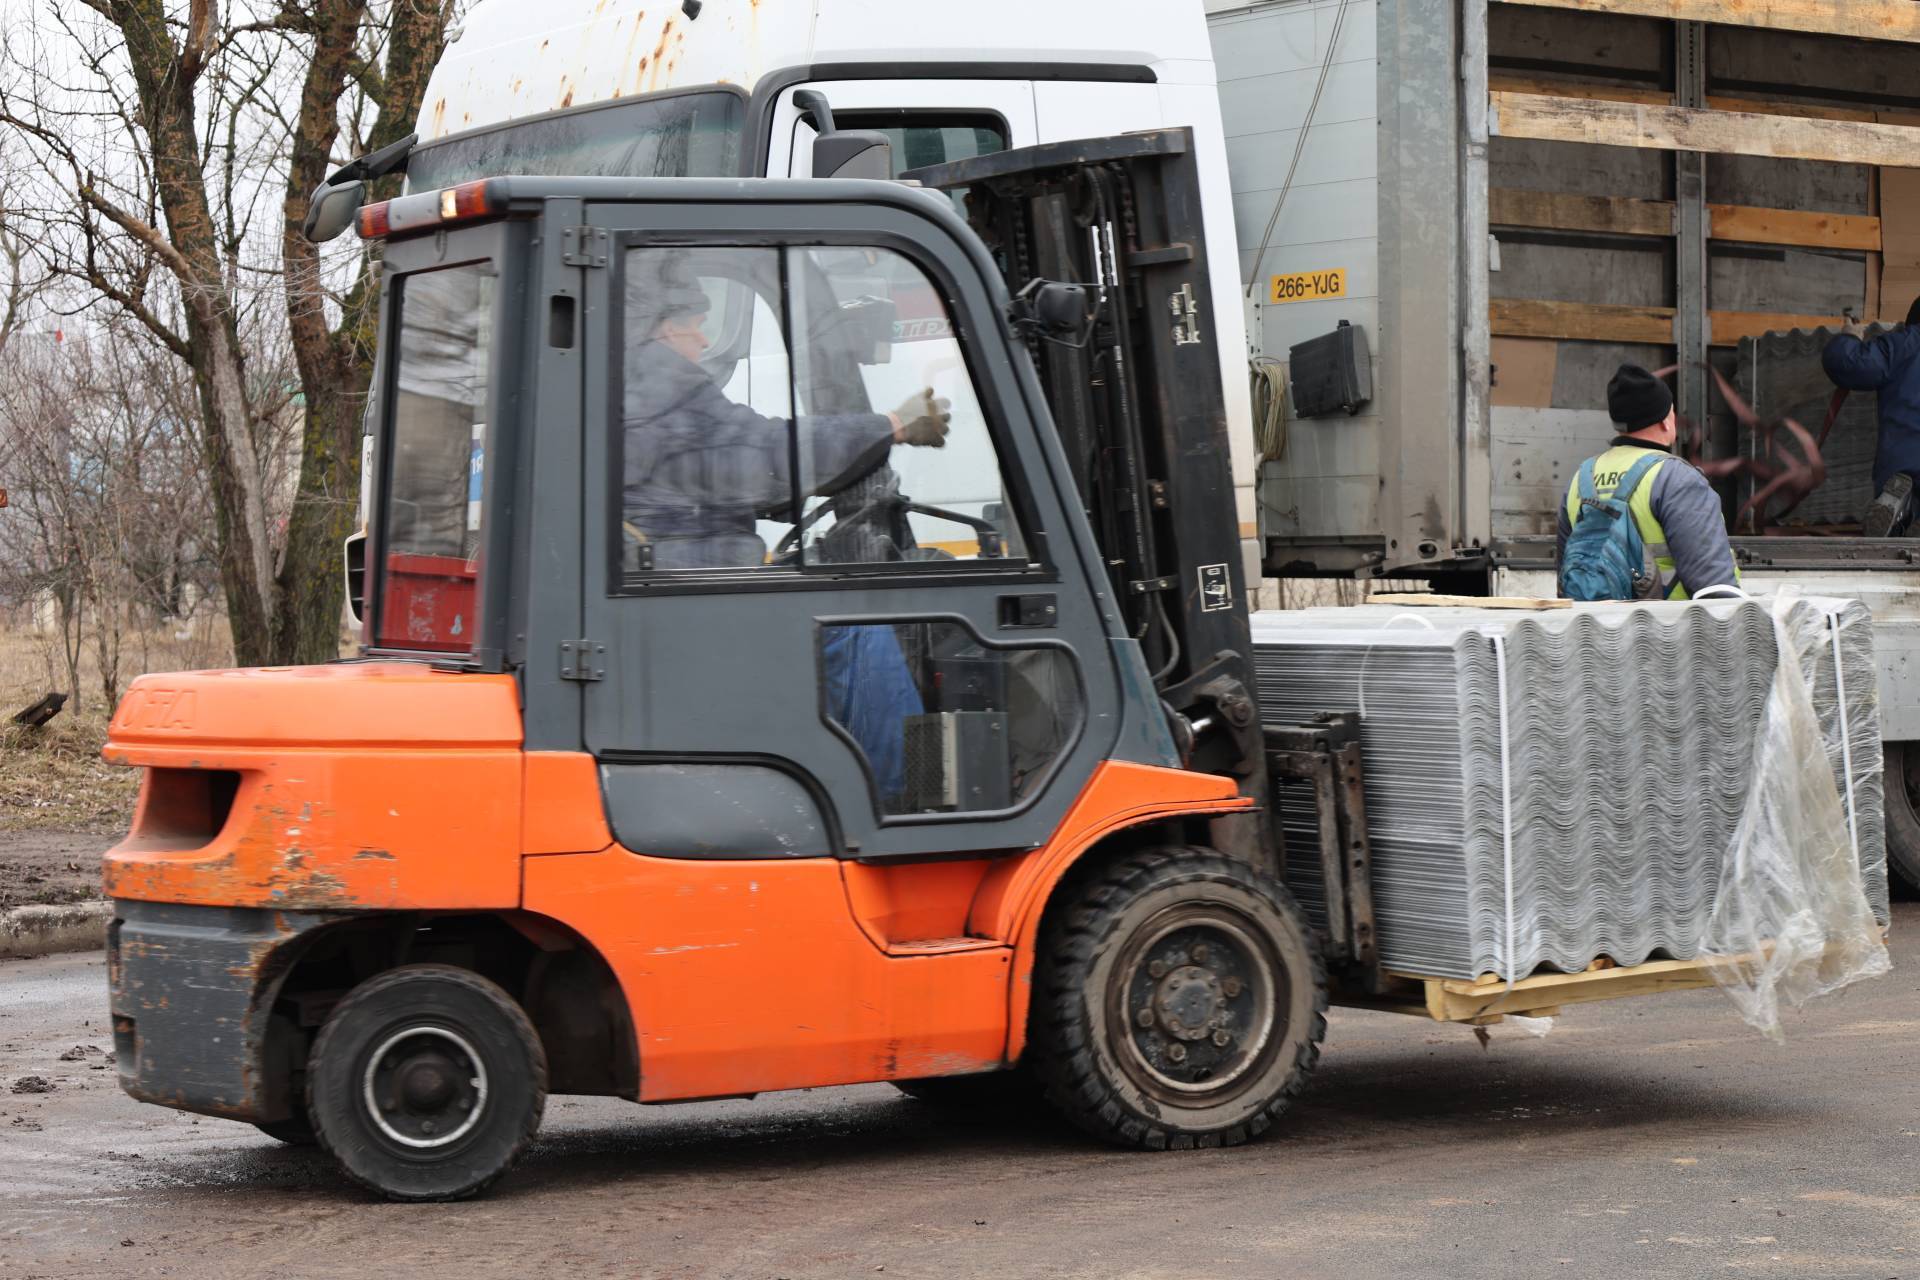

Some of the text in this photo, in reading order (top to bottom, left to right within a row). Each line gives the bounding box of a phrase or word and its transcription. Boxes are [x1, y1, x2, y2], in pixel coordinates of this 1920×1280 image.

[1277, 273, 1340, 298] 266-YJG
[1594, 471, 1628, 487] AR
[118, 687, 197, 730] OTA
